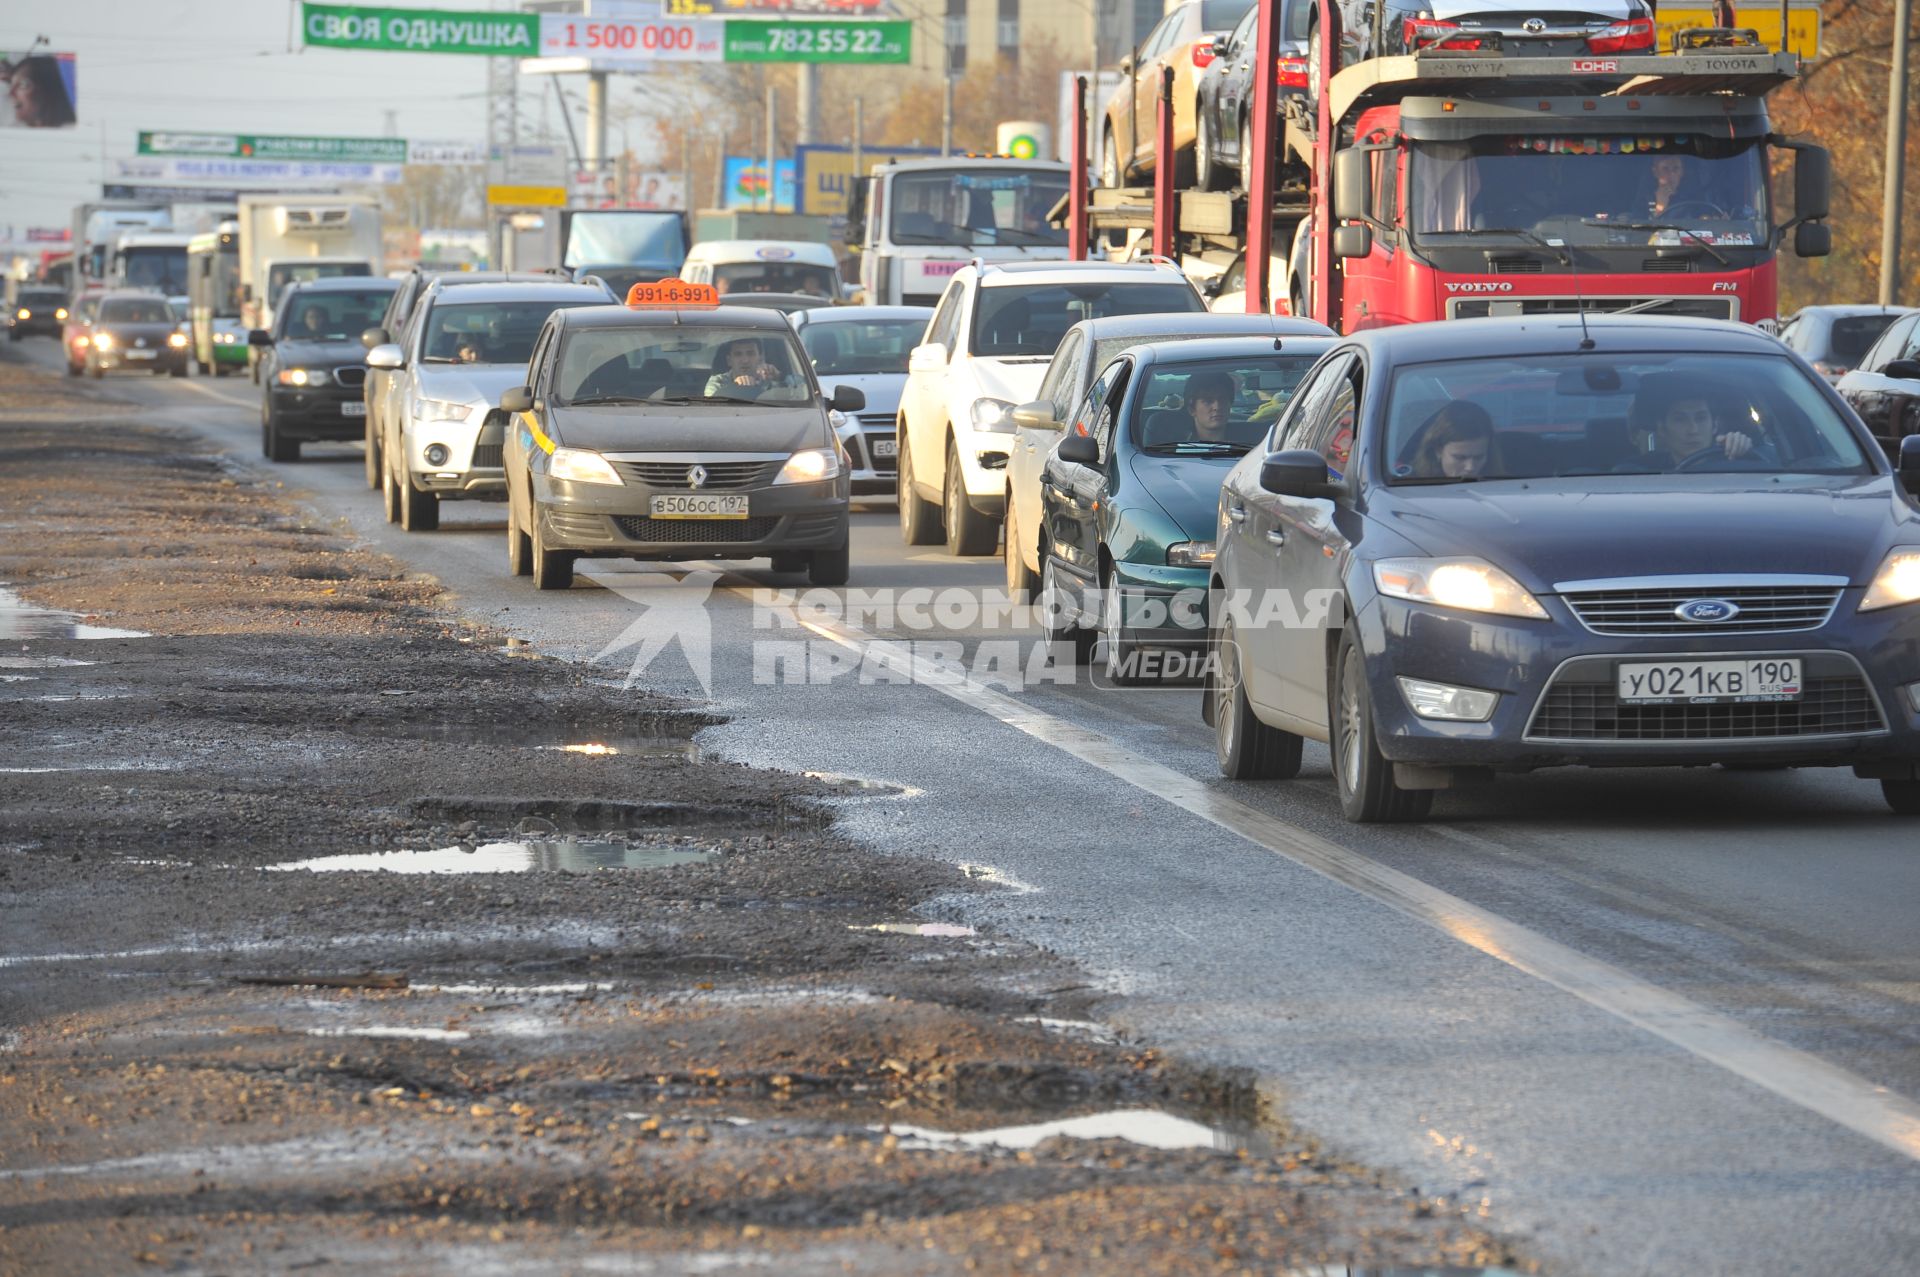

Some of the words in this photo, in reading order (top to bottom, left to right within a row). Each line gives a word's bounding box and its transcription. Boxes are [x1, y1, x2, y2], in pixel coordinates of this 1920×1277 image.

[307, 13, 381, 41] СВОЯ
[387, 18, 532, 48] ОДНУШКА
[1573, 61, 1617, 72] LOHR
[1706, 60, 1758, 70] TOYOTA
[1444, 282, 1513, 292] VOLVO
[1712, 282, 1738, 291] FM
[635, 287, 711, 302] 991-6-991
[721, 496, 743, 509] 197
[1693, 604, 1722, 616] Ford
[1751, 662, 1793, 684] 190
[1760, 684, 1781, 693] RUS
